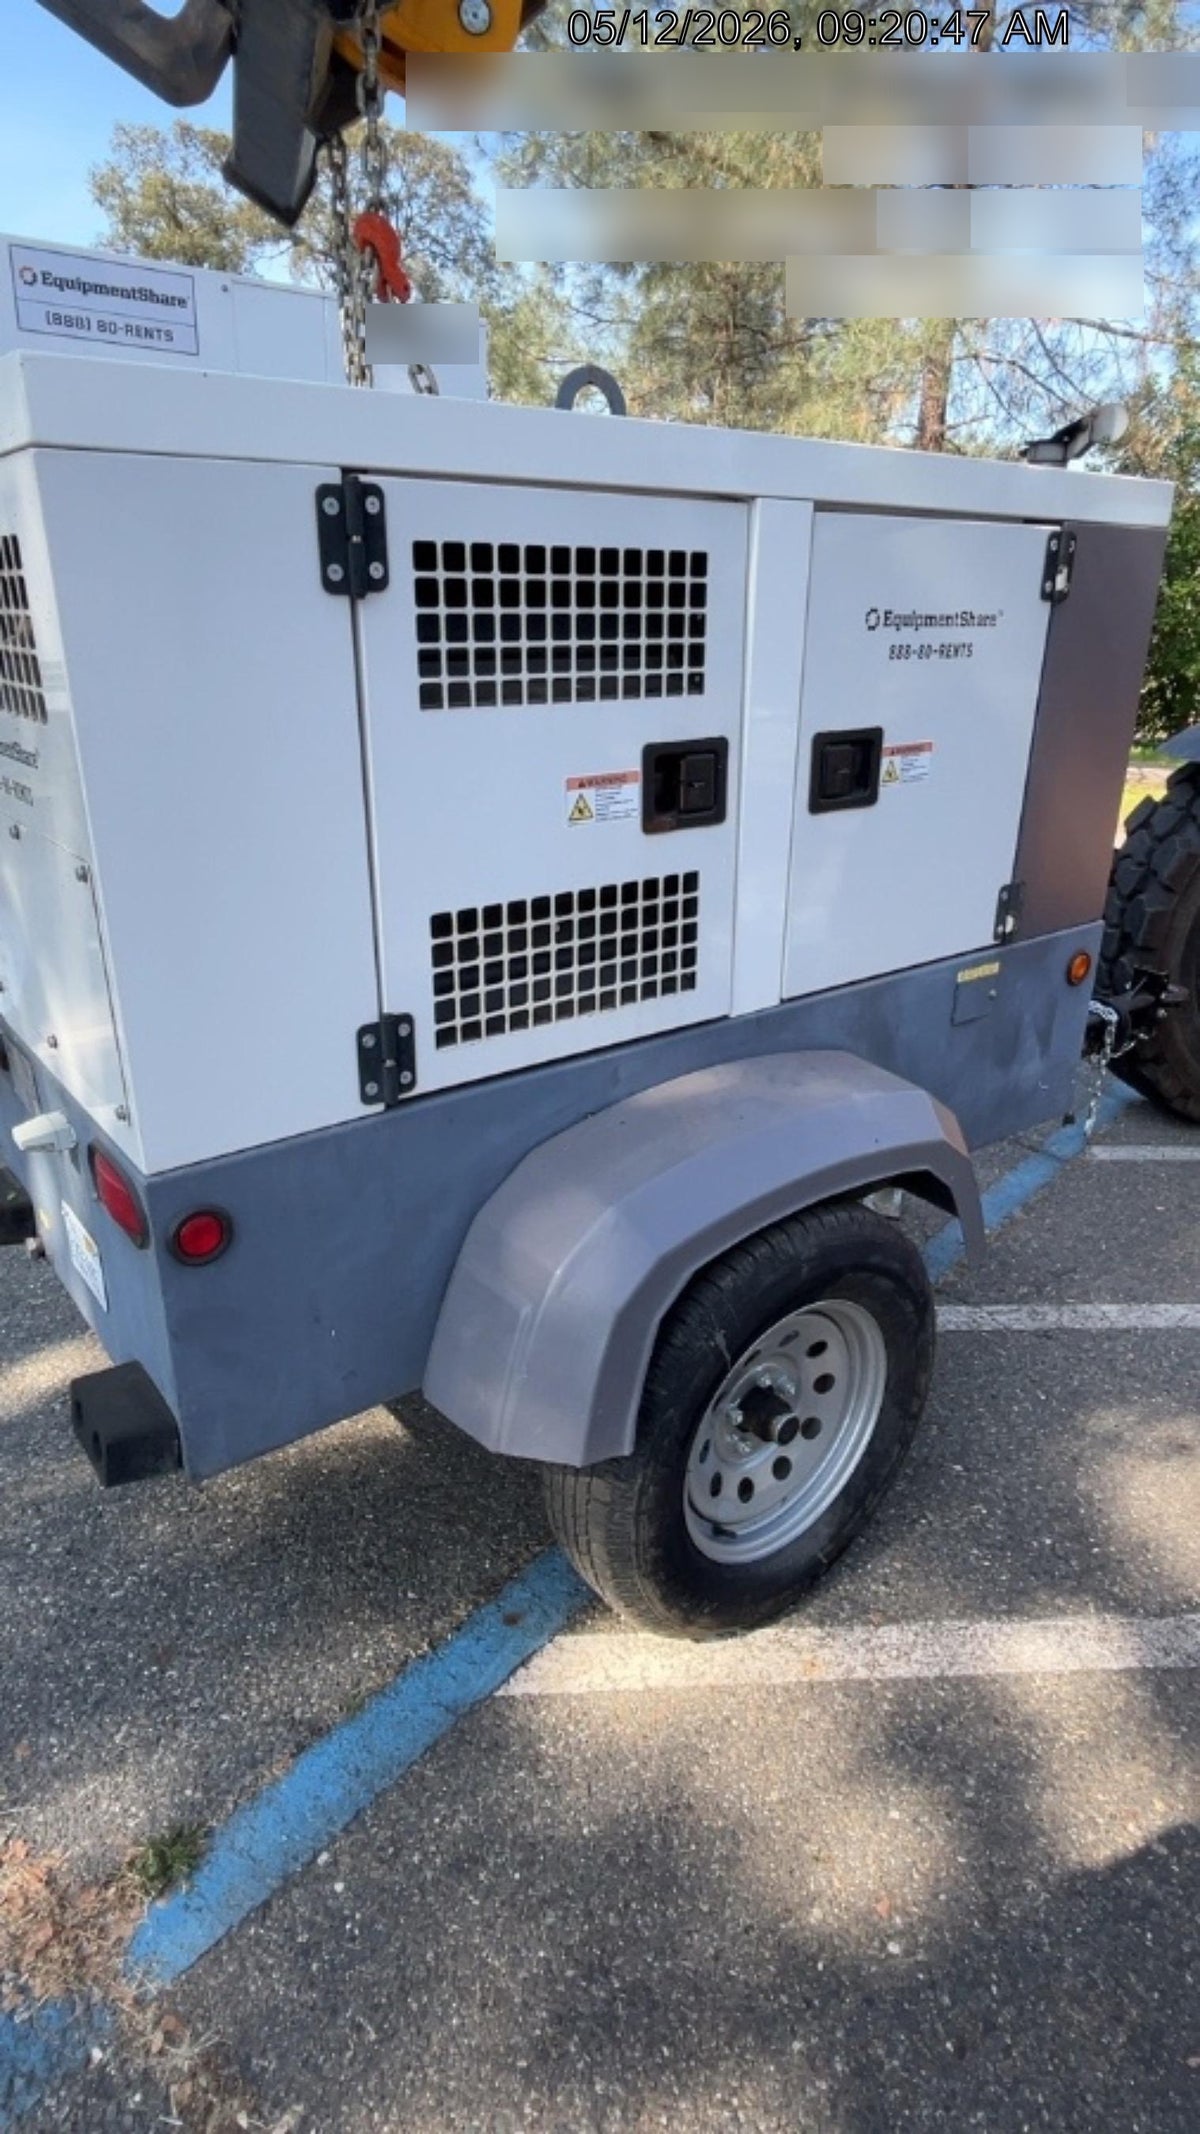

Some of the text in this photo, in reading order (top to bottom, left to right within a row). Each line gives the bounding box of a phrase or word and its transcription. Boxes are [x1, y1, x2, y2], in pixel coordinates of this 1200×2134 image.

[40, 270, 188, 309] EquipmentShare
[97, 318, 175, 342] 80-RENTS
[883, 609, 998, 631] EquipmentShare
[889, 642, 974, 660] 888-80-RENTS
